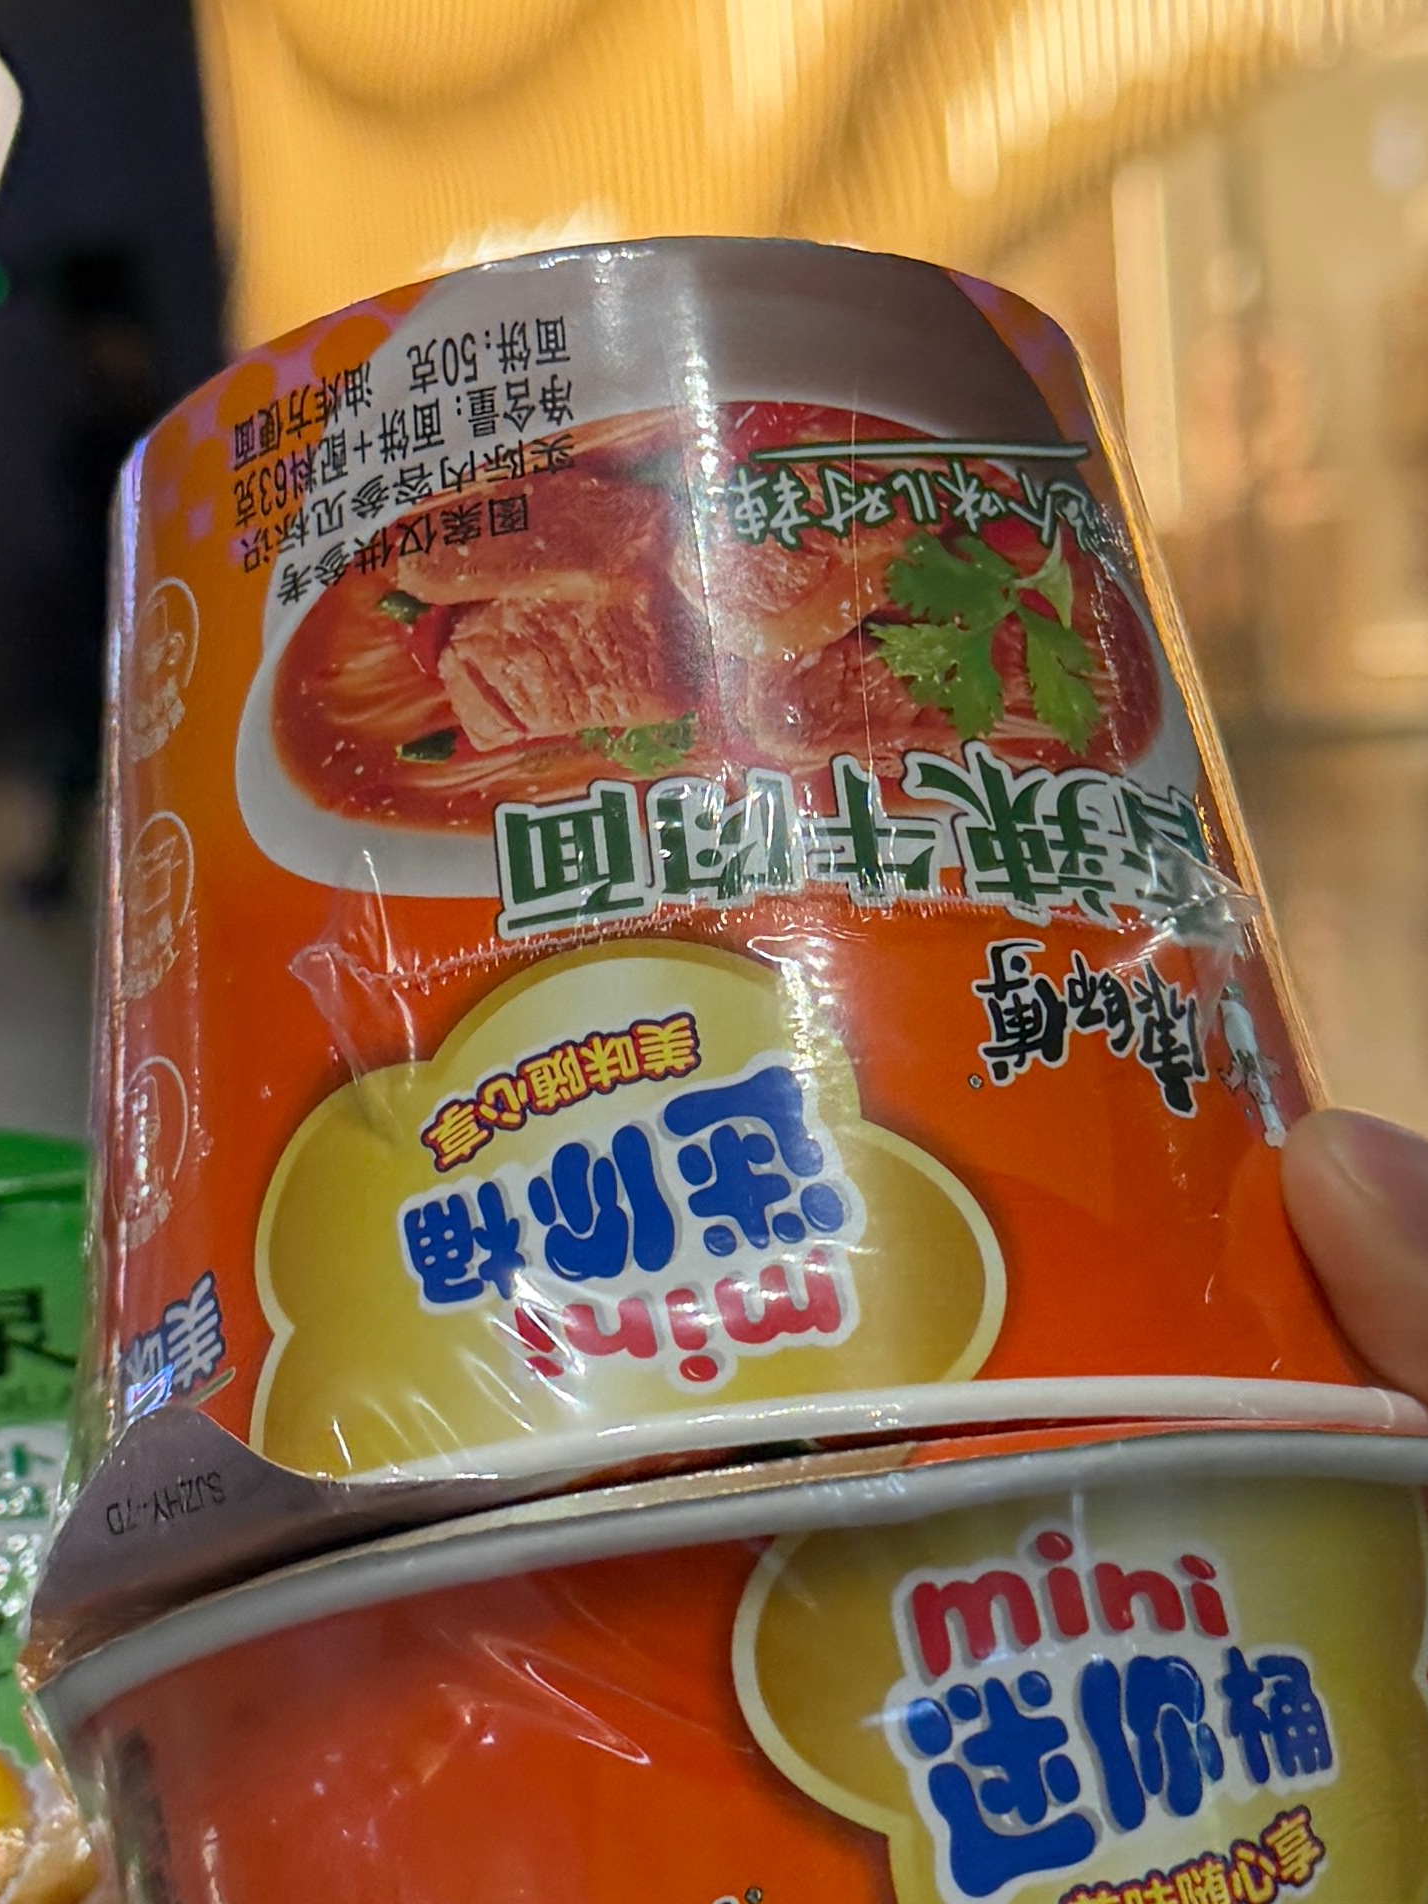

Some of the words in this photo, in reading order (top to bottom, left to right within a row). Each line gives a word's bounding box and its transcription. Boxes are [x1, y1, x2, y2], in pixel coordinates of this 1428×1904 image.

[232, 360, 372, 472] 油炸方便面
[407, 315, 571, 393] 面饼:50克
[234, 372, 575, 528] 净含量:面饼+配料63克
[241, 432, 577, 574] 实际内容参见标识
[276, 492, 530, 607] 图案仅供参考
[422, 1012, 702, 1173] 美味随心享
[404, 1065, 846, 1305] 迷你桶
[512, 1248, 843, 1384] mini
[910, 1530, 1231, 1678] mini
[905, 1645, 1334, 1898] 迷你桶
